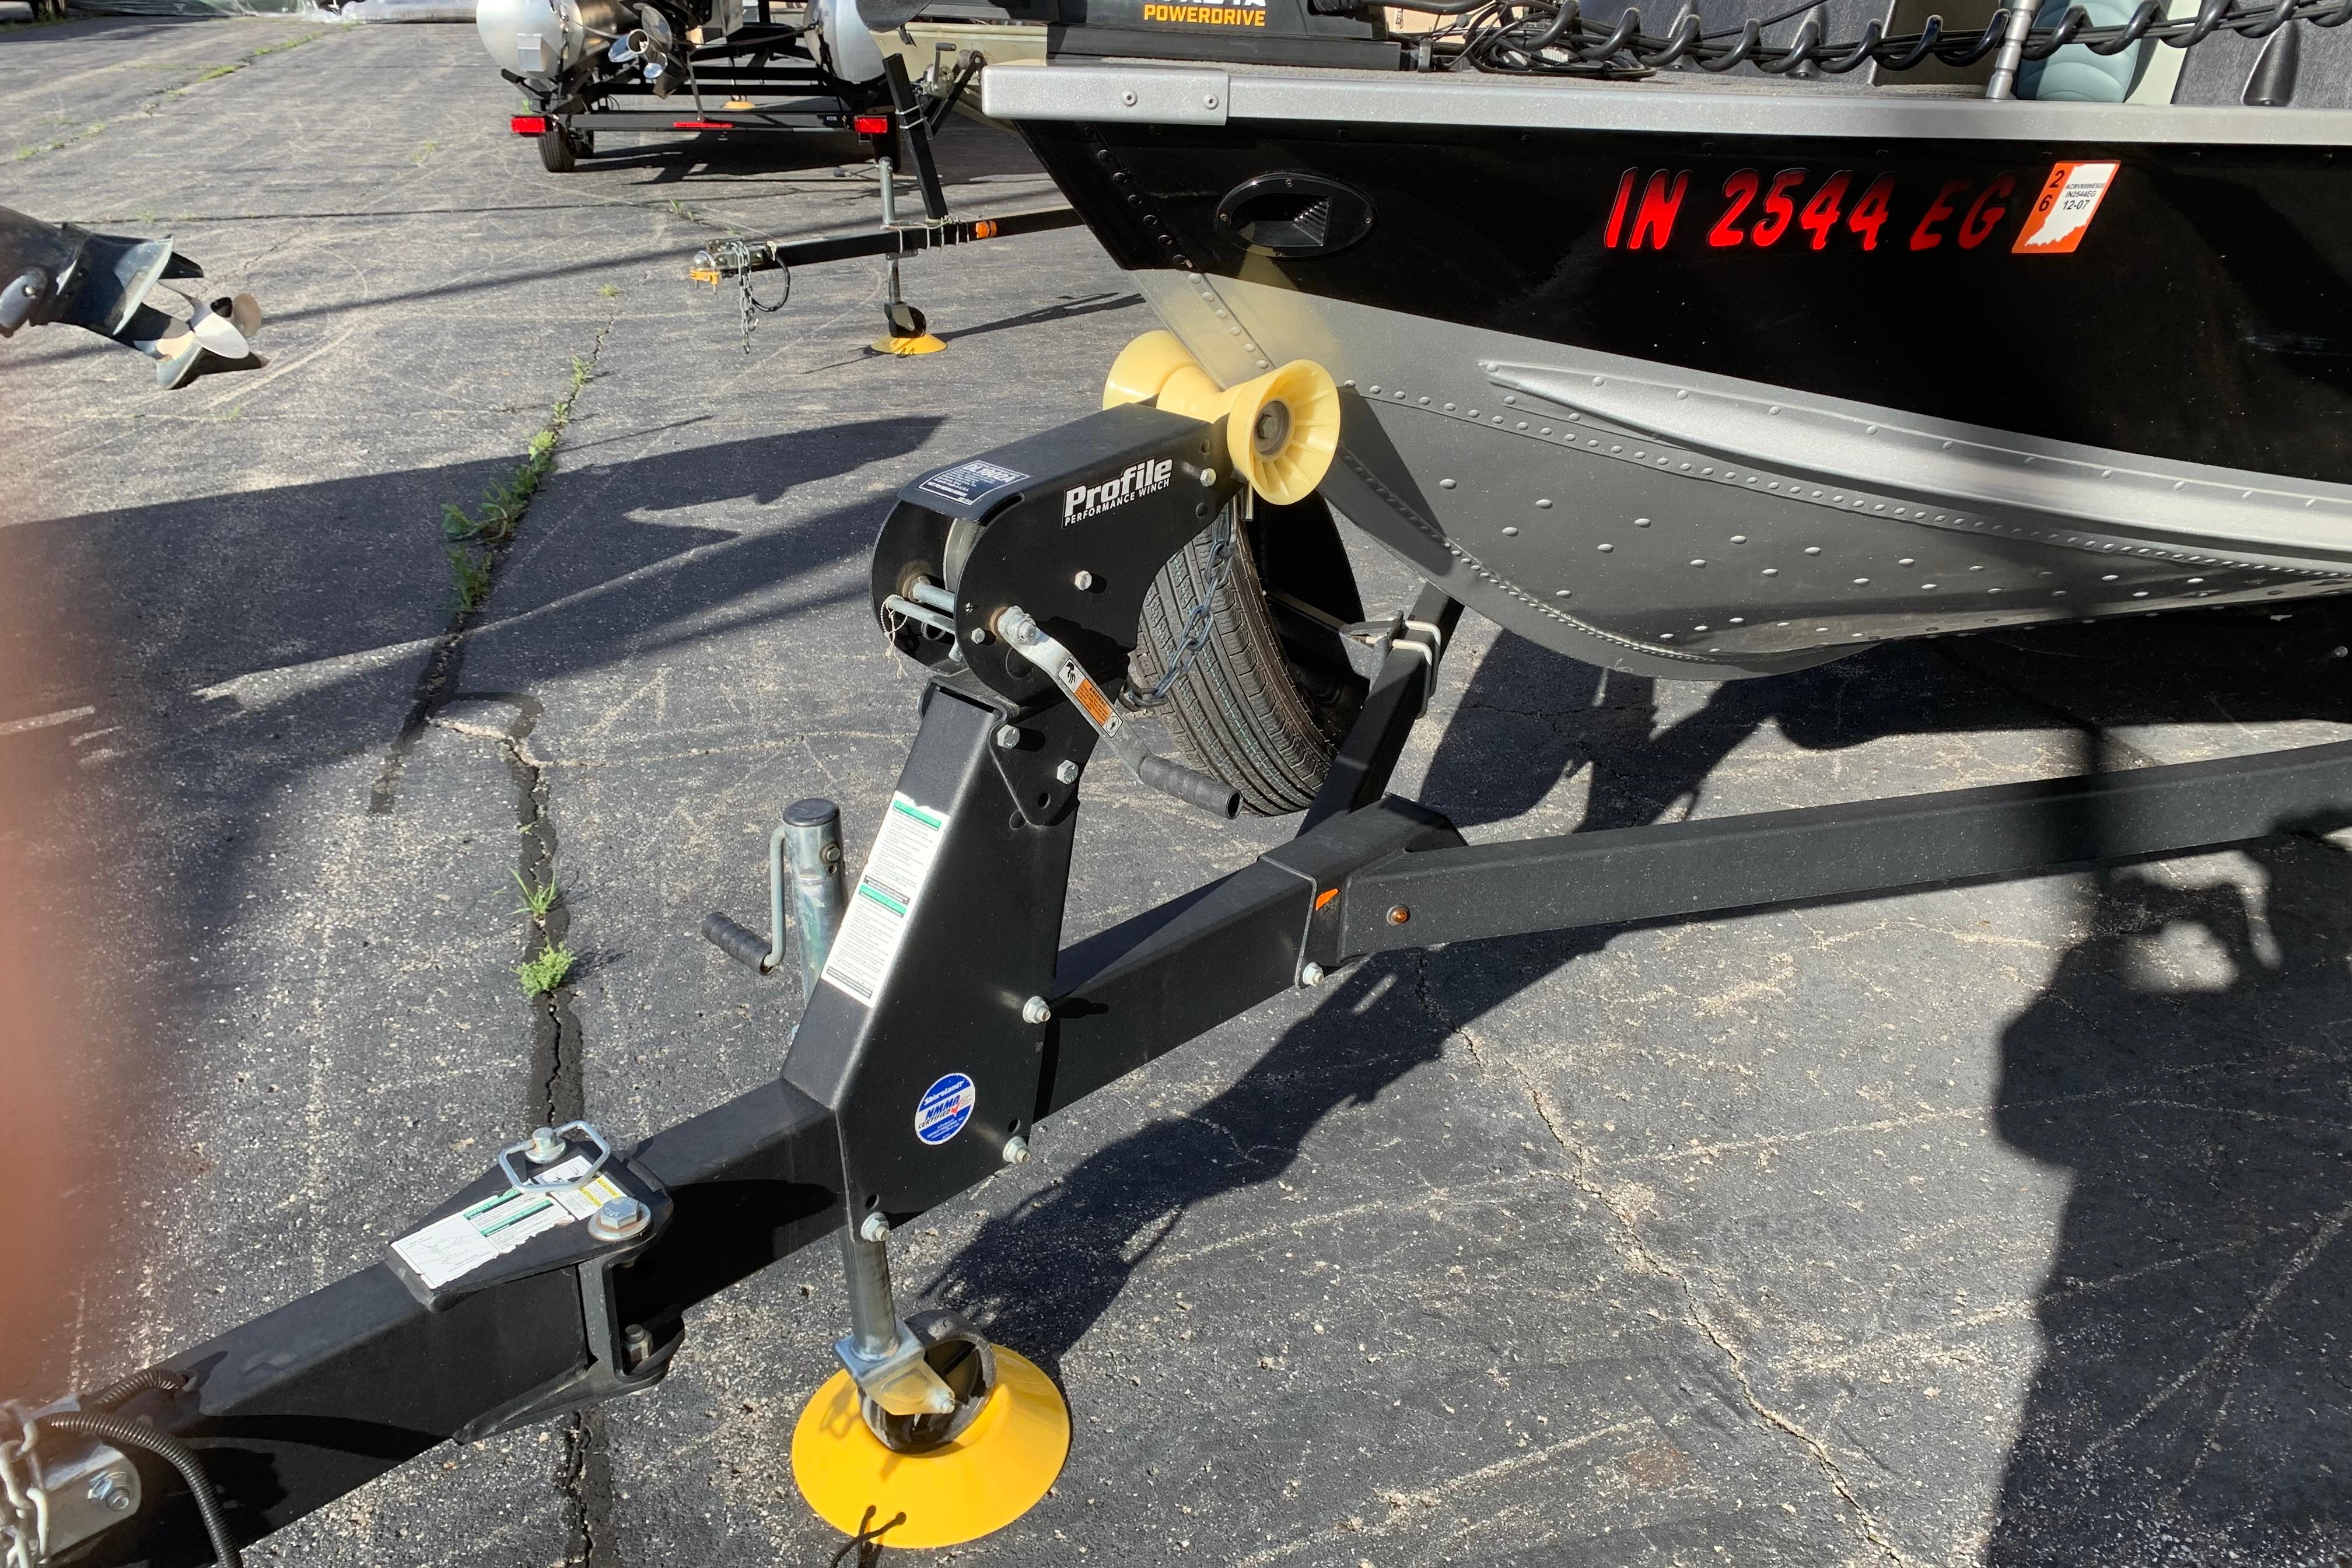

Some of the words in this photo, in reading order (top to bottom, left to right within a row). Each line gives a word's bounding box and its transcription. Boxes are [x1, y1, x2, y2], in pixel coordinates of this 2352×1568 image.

[1143, 4, 1266, 27] POWERDRIVE
[2049, 170, 2065, 188] 2
[1604, 167, 1692, 250] IN
[1707, 167, 1897, 251] 2544
[1909, 170, 2017, 251] EG
[2038, 194, 2053, 212] 6
[2063, 200, 2091, 211] 12-07
[962, 463, 1017, 483] DL1802A
[1064, 459, 1172, 518] Profile
[1065, 491, 1135, 527] PERFORMANCE
[1139, 478, 1170, 498] WINCH
[1092, 690, 1107, 708] WARNING
[918, 1108, 951, 1129] CERTIFIED
